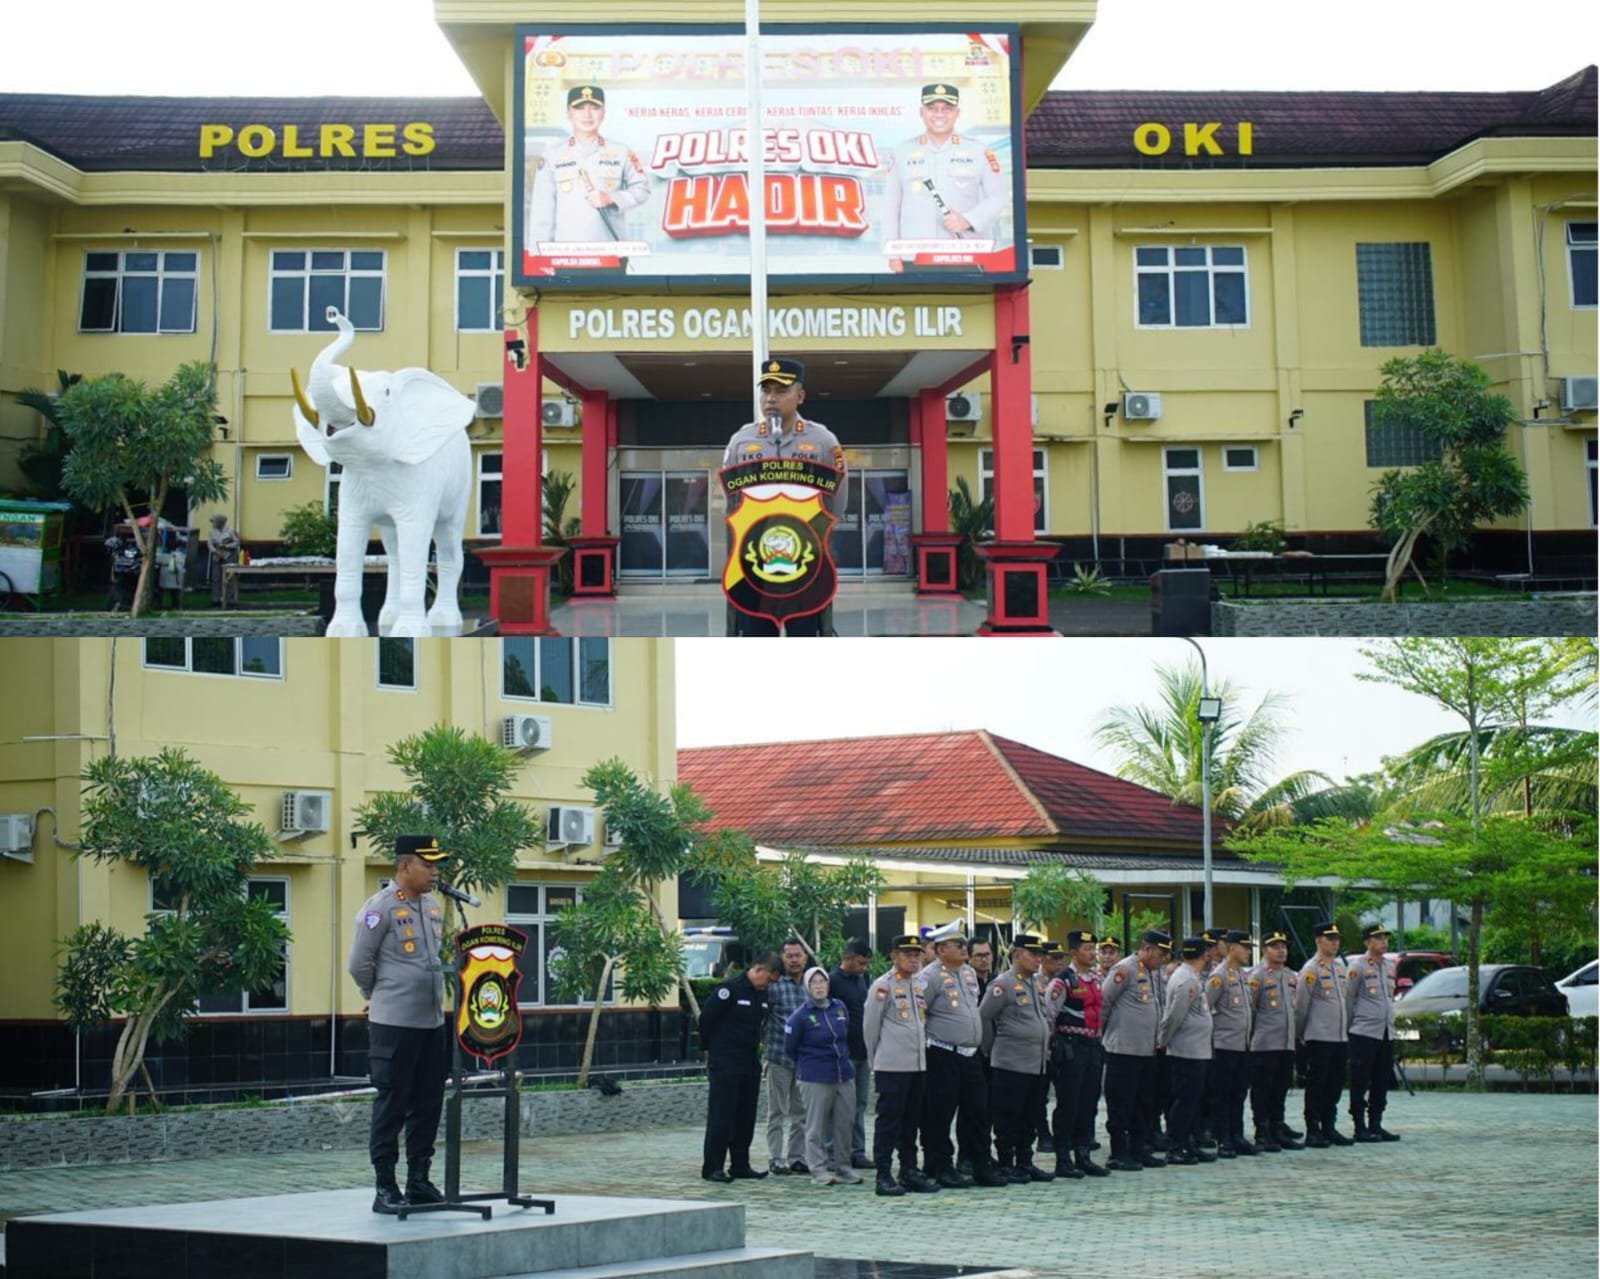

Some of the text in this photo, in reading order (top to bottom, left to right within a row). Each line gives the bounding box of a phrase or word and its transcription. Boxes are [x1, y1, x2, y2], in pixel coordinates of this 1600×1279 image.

[199, 121, 437, 158] POLRES
[651, 128, 879, 169] POLRES OKI
[1133, 121, 1253, 156] OKI
[663, 173, 869, 239] HADIR
[569, 306, 963, 339] POLRES OGAN KOMERING ILIR
[762, 461, 804, 470] POLRES
[791, 452, 818, 460] POLRI
[727, 471, 836, 490] OGAN KOMERING ILIR
